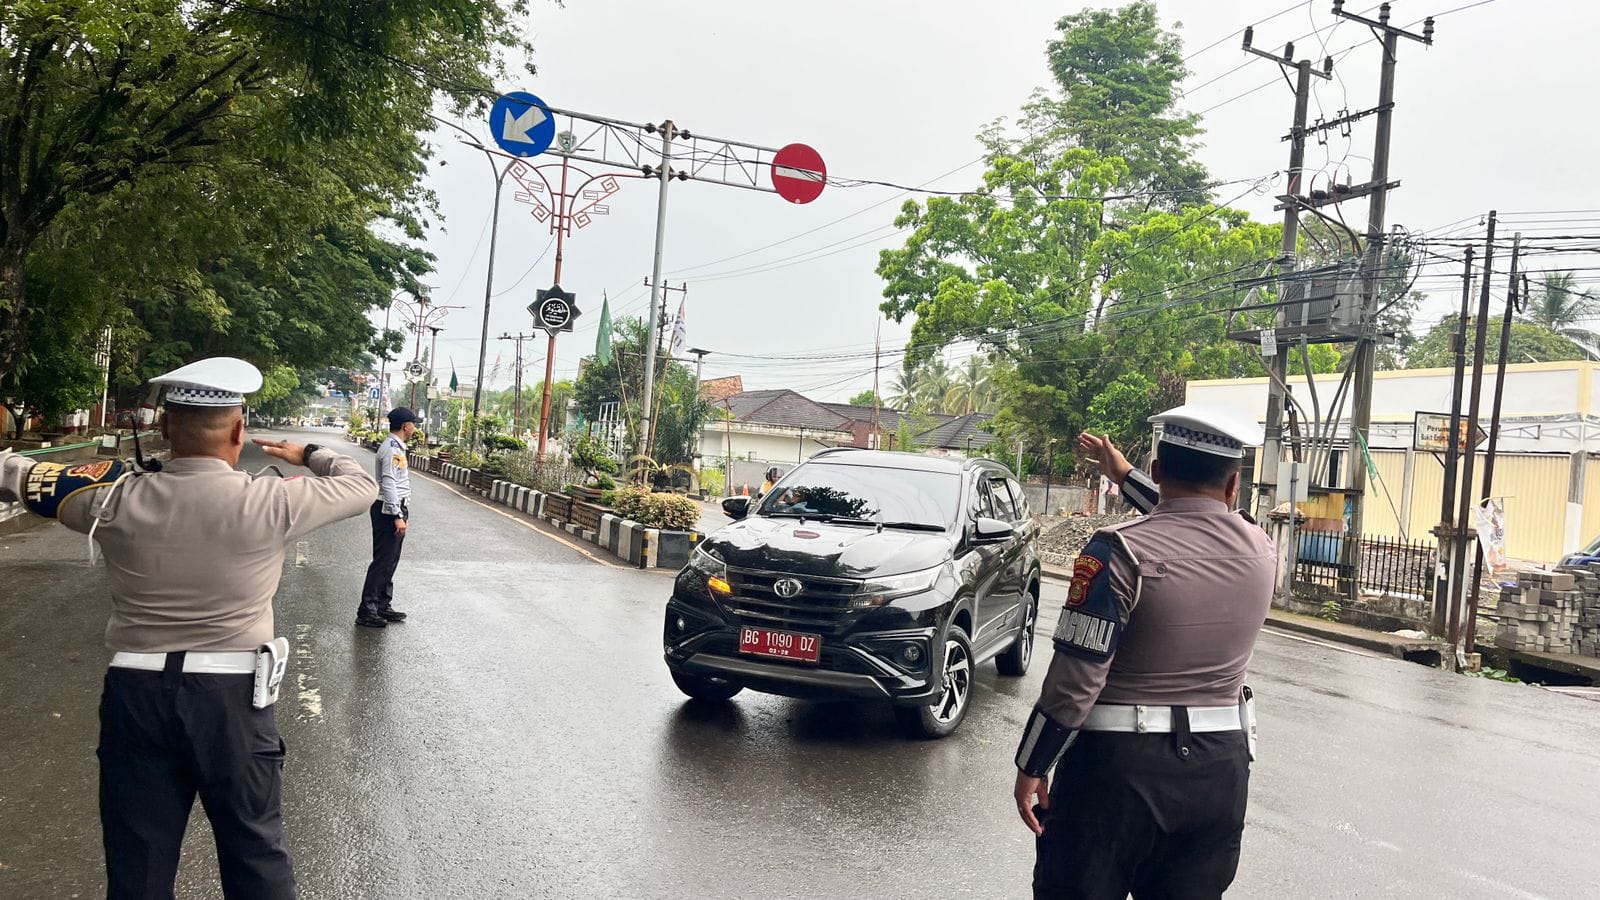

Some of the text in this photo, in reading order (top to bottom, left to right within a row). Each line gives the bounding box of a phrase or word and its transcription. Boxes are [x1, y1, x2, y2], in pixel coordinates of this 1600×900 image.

[41, 462, 66, 497] NIT
[745, 630, 815, 652] BG 1090 DZ
